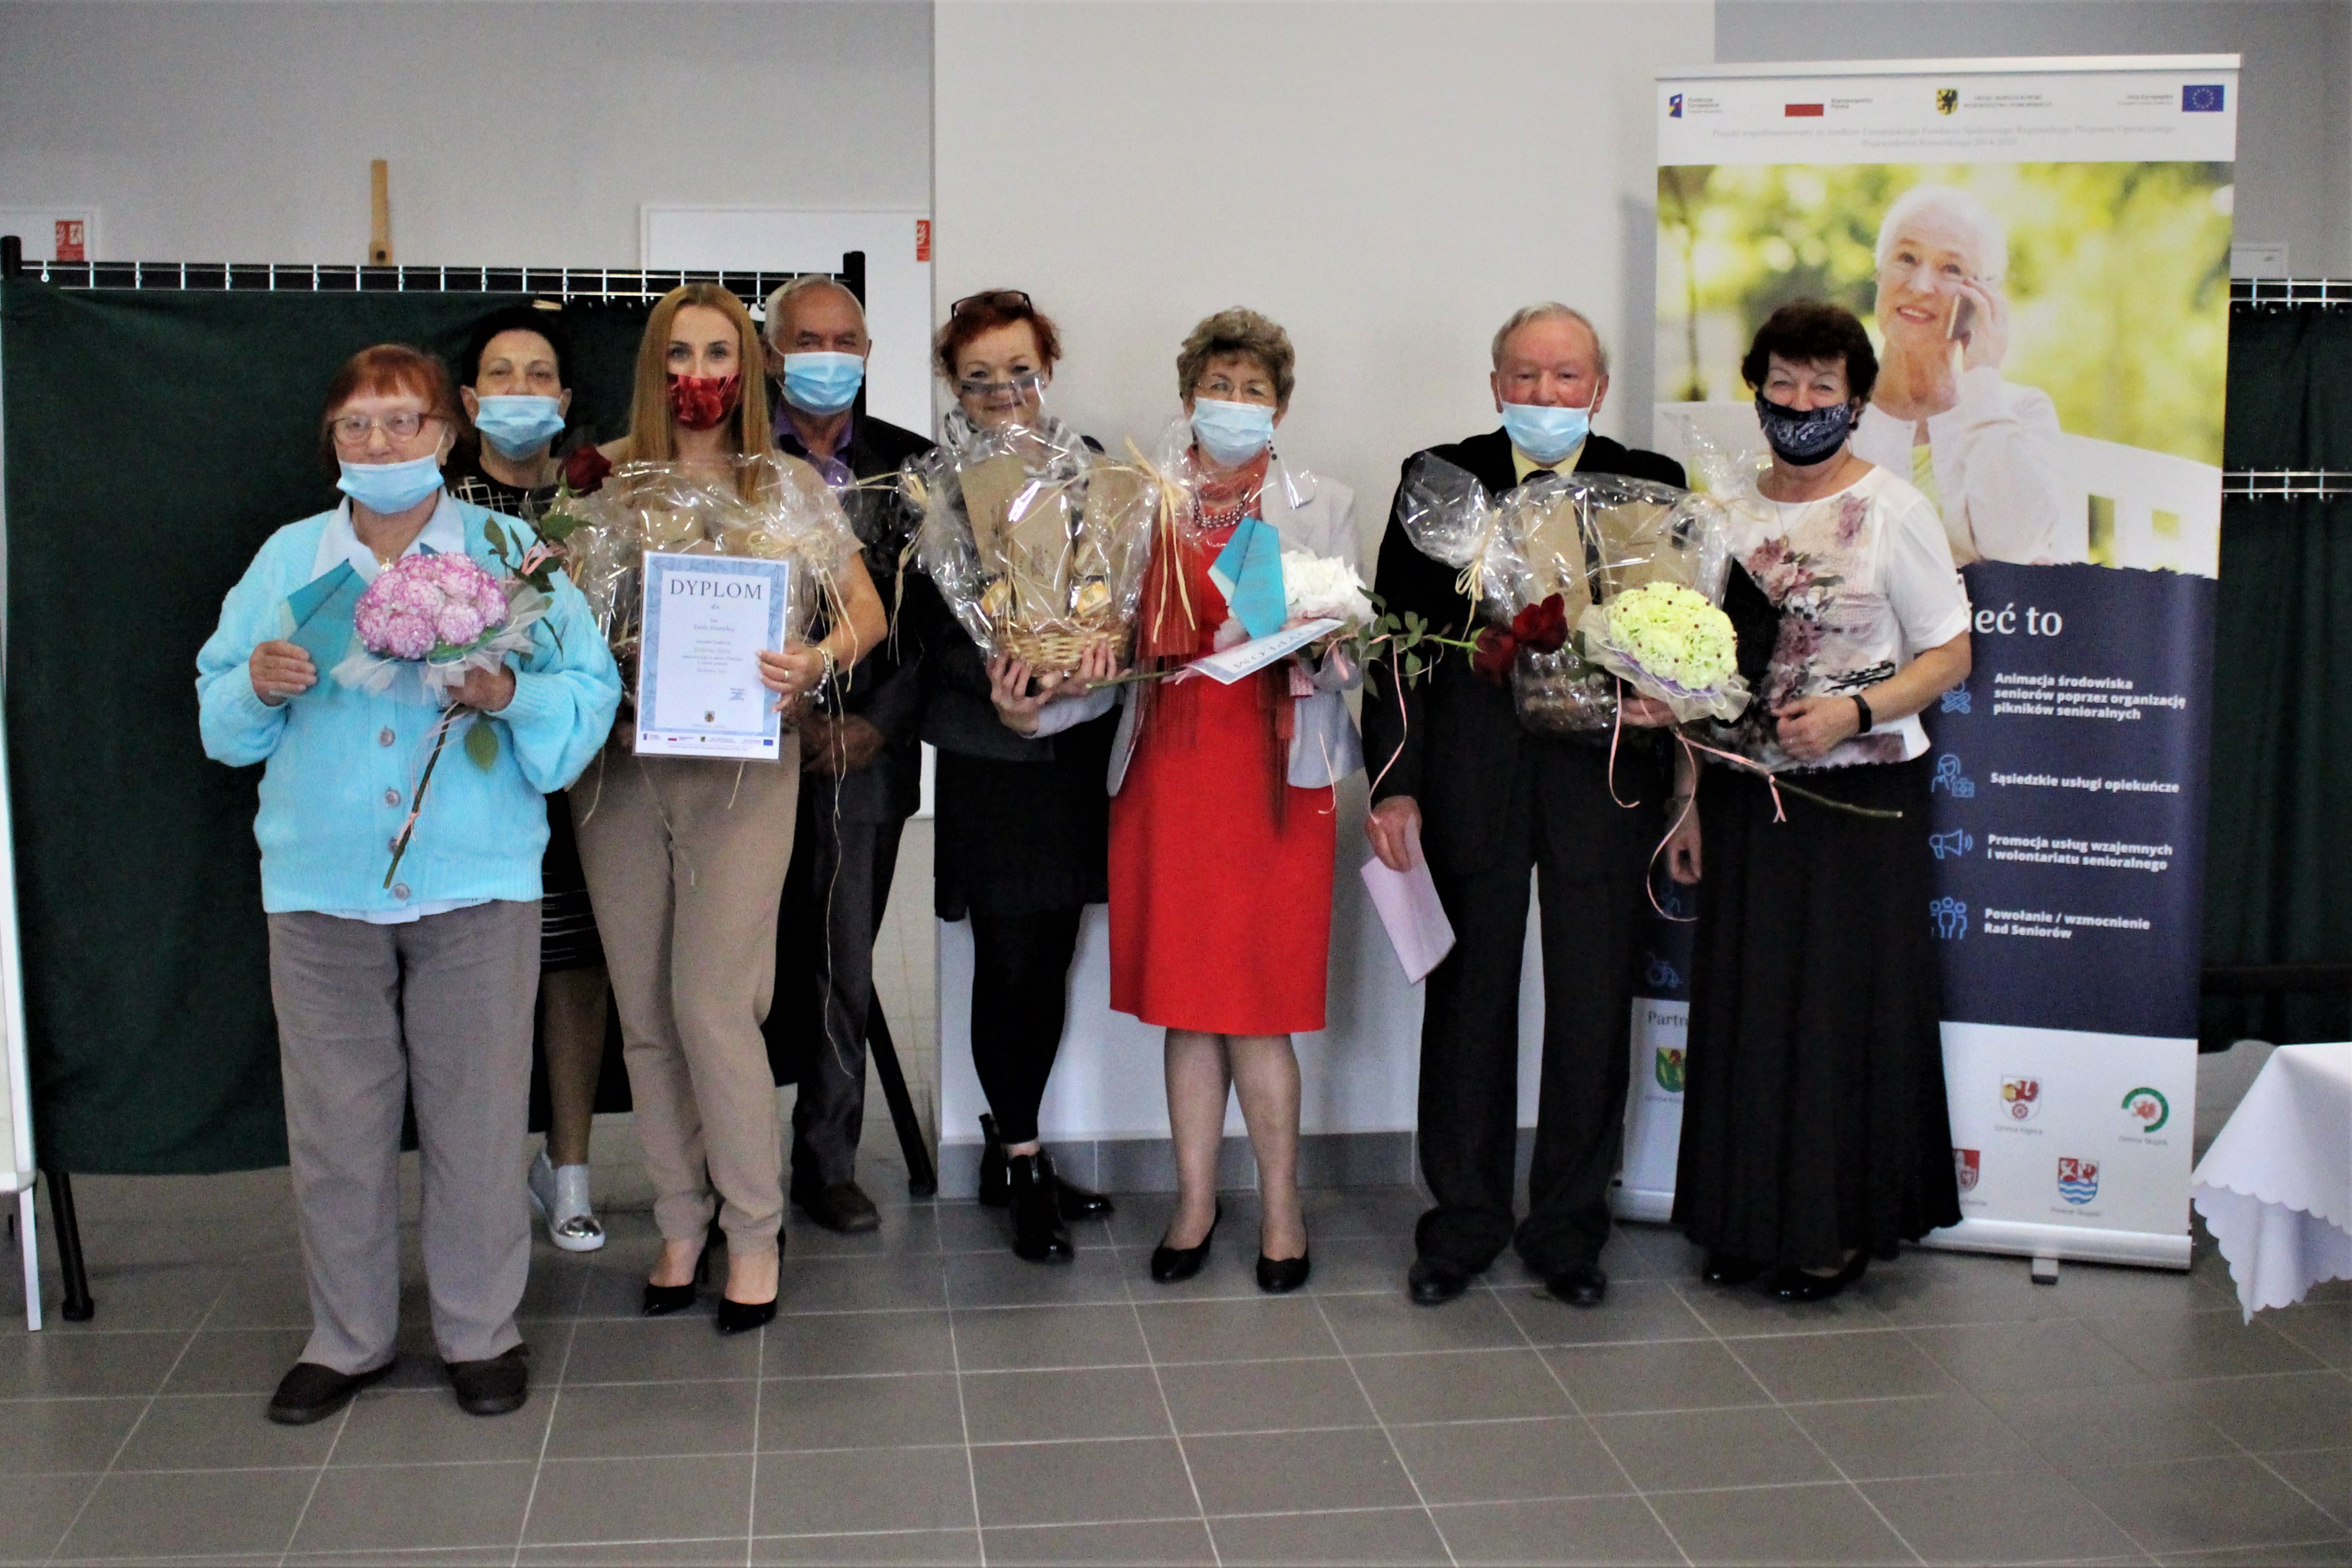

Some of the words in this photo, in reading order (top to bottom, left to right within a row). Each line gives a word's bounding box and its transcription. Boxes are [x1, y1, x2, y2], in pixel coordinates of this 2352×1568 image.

[671, 579, 761, 600] DYPLOM
[1968, 601, 2016, 634] eć
[2026, 606, 2063, 636] to
[1994, 673, 2055, 689] Animacja
[2058, 675, 2133, 690] środowiska
[1994, 688, 2054, 701] seniorów
[2057, 692, 2108, 705] poprzez
[2110, 694, 2186, 710] organizację
[1993, 701, 2054, 716] pikników
[2057, 706, 2141, 722] senioralnych
[1990, 772, 2058, 786] Sąsiedzkie
[2062, 776, 2101, 792] usługi
[2104, 780, 2180, 793] opiekuńcze
[1988, 834, 2048, 850] Promocja
[2051, 838, 2088, 854] usług
[2091, 840, 2173, 857] wzajemnych
[1988, 849, 1992, 859] i
[1995, 850, 2080, 865] wolontariatu
[2082, 856, 2168, 872] senioralnego
[1985, 907, 2053, 923] Powołanie
[2055, 913, 2062, 924] /
[2064, 915, 2151, 930] wzmocnienie
[1984, 922, 2009, 935] Rad
[2011, 925, 2072, 939] Seniorów
[1648, 1011, 1689, 1027] Partn
